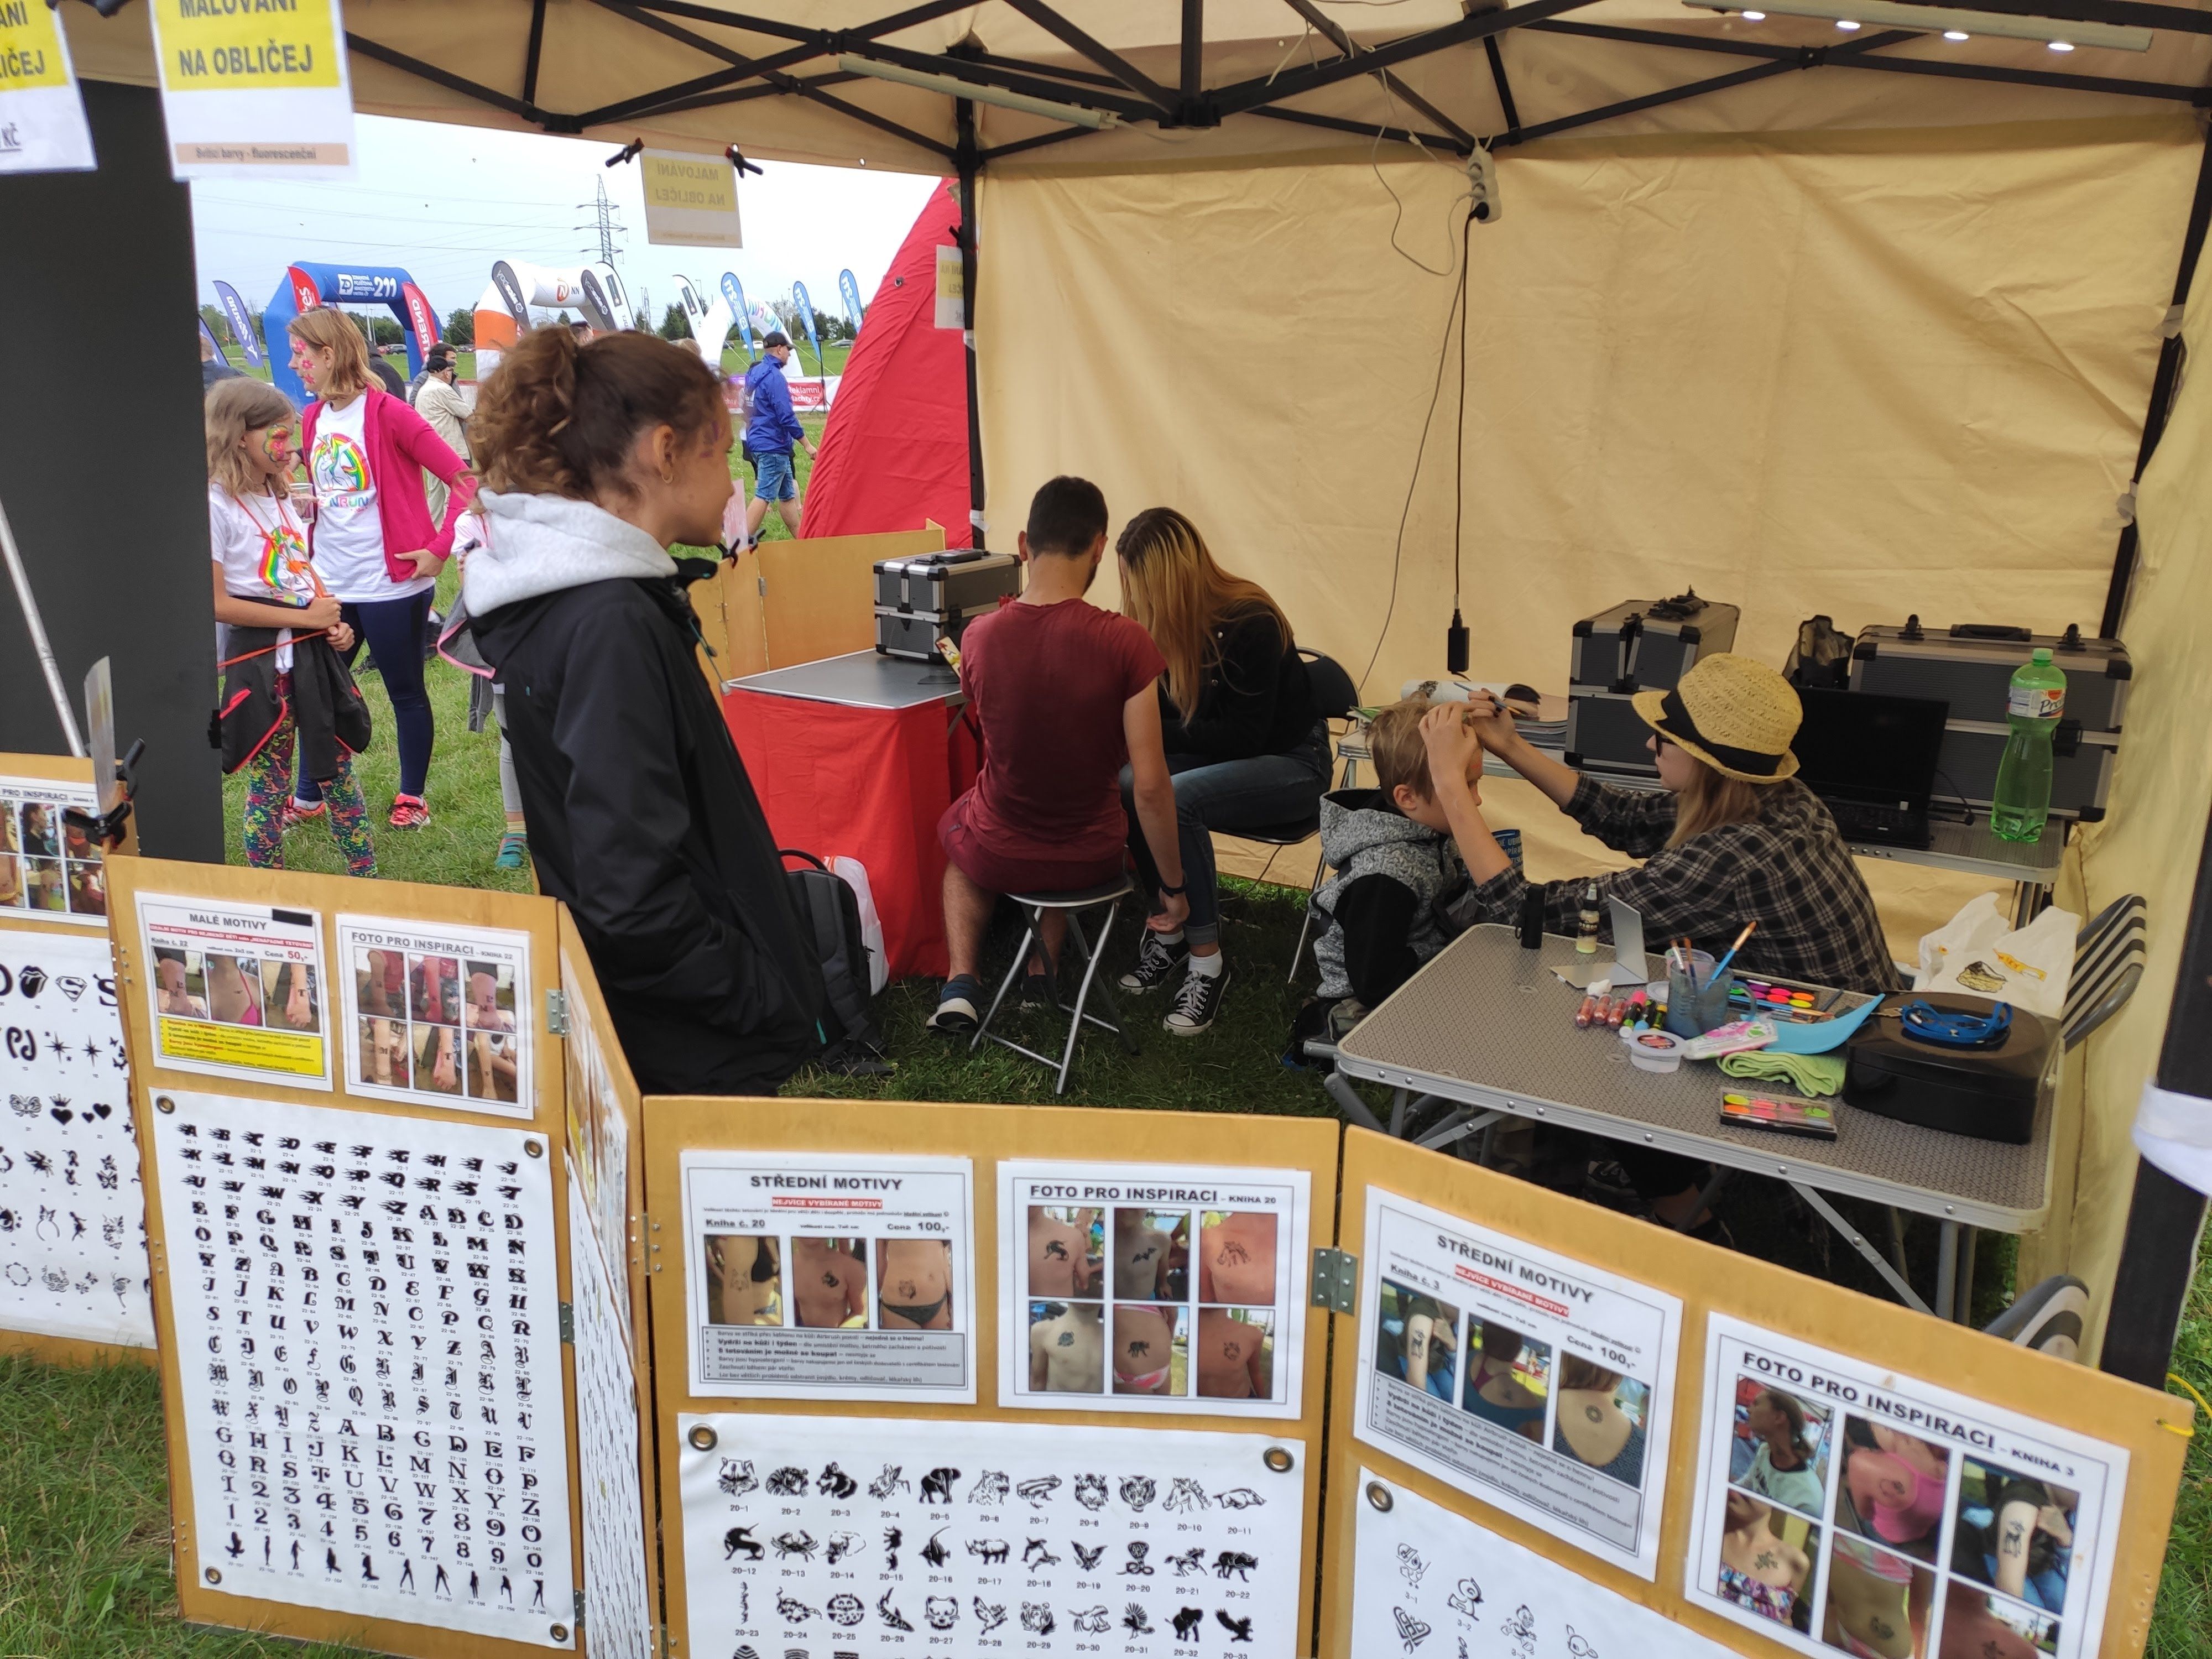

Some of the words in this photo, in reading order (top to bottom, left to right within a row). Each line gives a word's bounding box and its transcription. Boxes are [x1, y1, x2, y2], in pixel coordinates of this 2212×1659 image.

[179, 49, 208, 76] NA
[213, 38, 314, 75] OBLIČEJ
[374, 276, 397, 298] 211
[190, 914, 220, 925] MALÉ
[223, 917, 267, 930] MOTIVY
[352, 932, 382, 943] FOTO
[387, 936, 410, 947] PRO
[414, 940, 474, 954] INSPIRACI
[750, 1173, 827, 1189] STŘEDNÍ
[834, 1177, 902, 1190] MOTIVY
[1031, 1185, 1077, 1198] FOTO
[1084, 1187, 1120, 1199] PRO
[1127, 1188, 1218, 1202] INSPIRACI
[1229, 1194, 1261, 1203] KNIHA
[706, 1219, 735, 1227] Kniha
[1391, 1264, 1418, 1281] Kniha
[1433, 1280, 1440, 1290] 3
[1438, 1234, 1514, 1274] STŘEDNÍ
[1520, 1265, 1594, 1303] MOTIVY
[1567, 1334, 1593, 1351] Cena
[1743, 1350, 1802, 1383] FOTO
[1812, 1375, 1858, 1401] PRO
[1867, 1393, 1995, 1448] INSPIRACI
[2011, 1448, 2060, 1473] KNIHA
[2067, 1467, 2075, 1477] 3
[410, 1455, 431, 1474] M
[448, 1461, 467, 1479] N
[345, 1470, 362, 1488] U
[379, 1475, 398, 1493] V
[415, 1481, 436, 1498] W
[452, 1487, 470, 1505] X
[484, 1493, 505, 1510] Y
[522, 1498, 540, 1517] Z
[283, 1486, 300, 1504] 3
[352, 1498, 369, 1515] 5
[384, 1503, 403, 1520] 6
[418, 1507, 436, 1525] 7
[454, 1514, 471, 1531] 8
[486, 1519, 505, 1537] 9
[781, 1507, 801, 1516] 20-2
[880, 1510, 900, 1519] 20-4
[1030, 1516, 1049, 1525] 20-7
[1177, 1522, 1202, 1532] 20-10
[731, 1567, 757, 1575] 20-12
[781, 1569, 806, 1578] 20-13
[830, 1571, 854, 1579] 20-14
[978, 1577, 1002, 1585] 20-17
[1125, 1583, 1151, 1593] 20-20
[1176, 1586, 1199, 1595] 20-21
[1225, 1589, 1250, 1599] 20-22
[735, 1629, 759, 1637] 20-23
[783, 1631, 808, 1639] 20-24
[929, 1636, 953, 1645] 20-27
[1026, 1641, 1051, 1649] 20-29
[1076, 1643, 1100, 1652] 20-30
[1124, 1645, 1148, 1653] 20-31
[1173, 1648, 1198, 1657] 20-32
